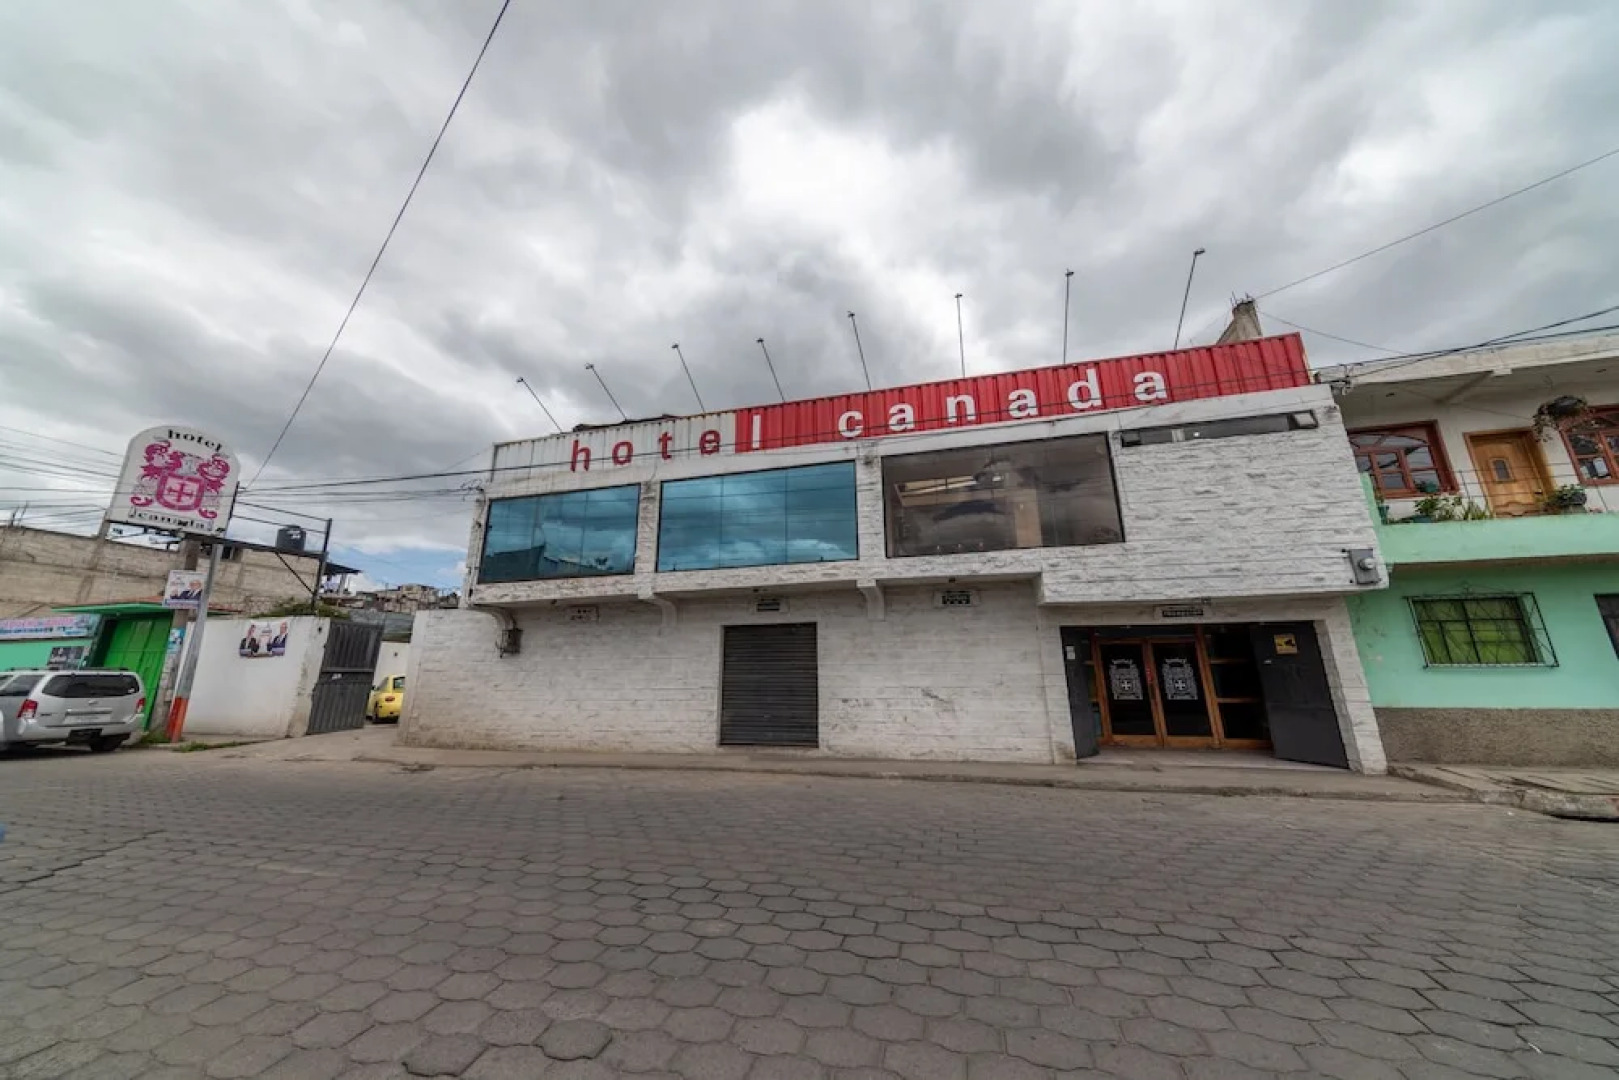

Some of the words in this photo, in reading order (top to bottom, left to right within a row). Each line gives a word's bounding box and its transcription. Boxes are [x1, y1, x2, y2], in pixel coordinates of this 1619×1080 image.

[168, 429, 222, 452] hotel
[570, 414, 762, 472] hotel
[838, 368, 1168, 438] canada
